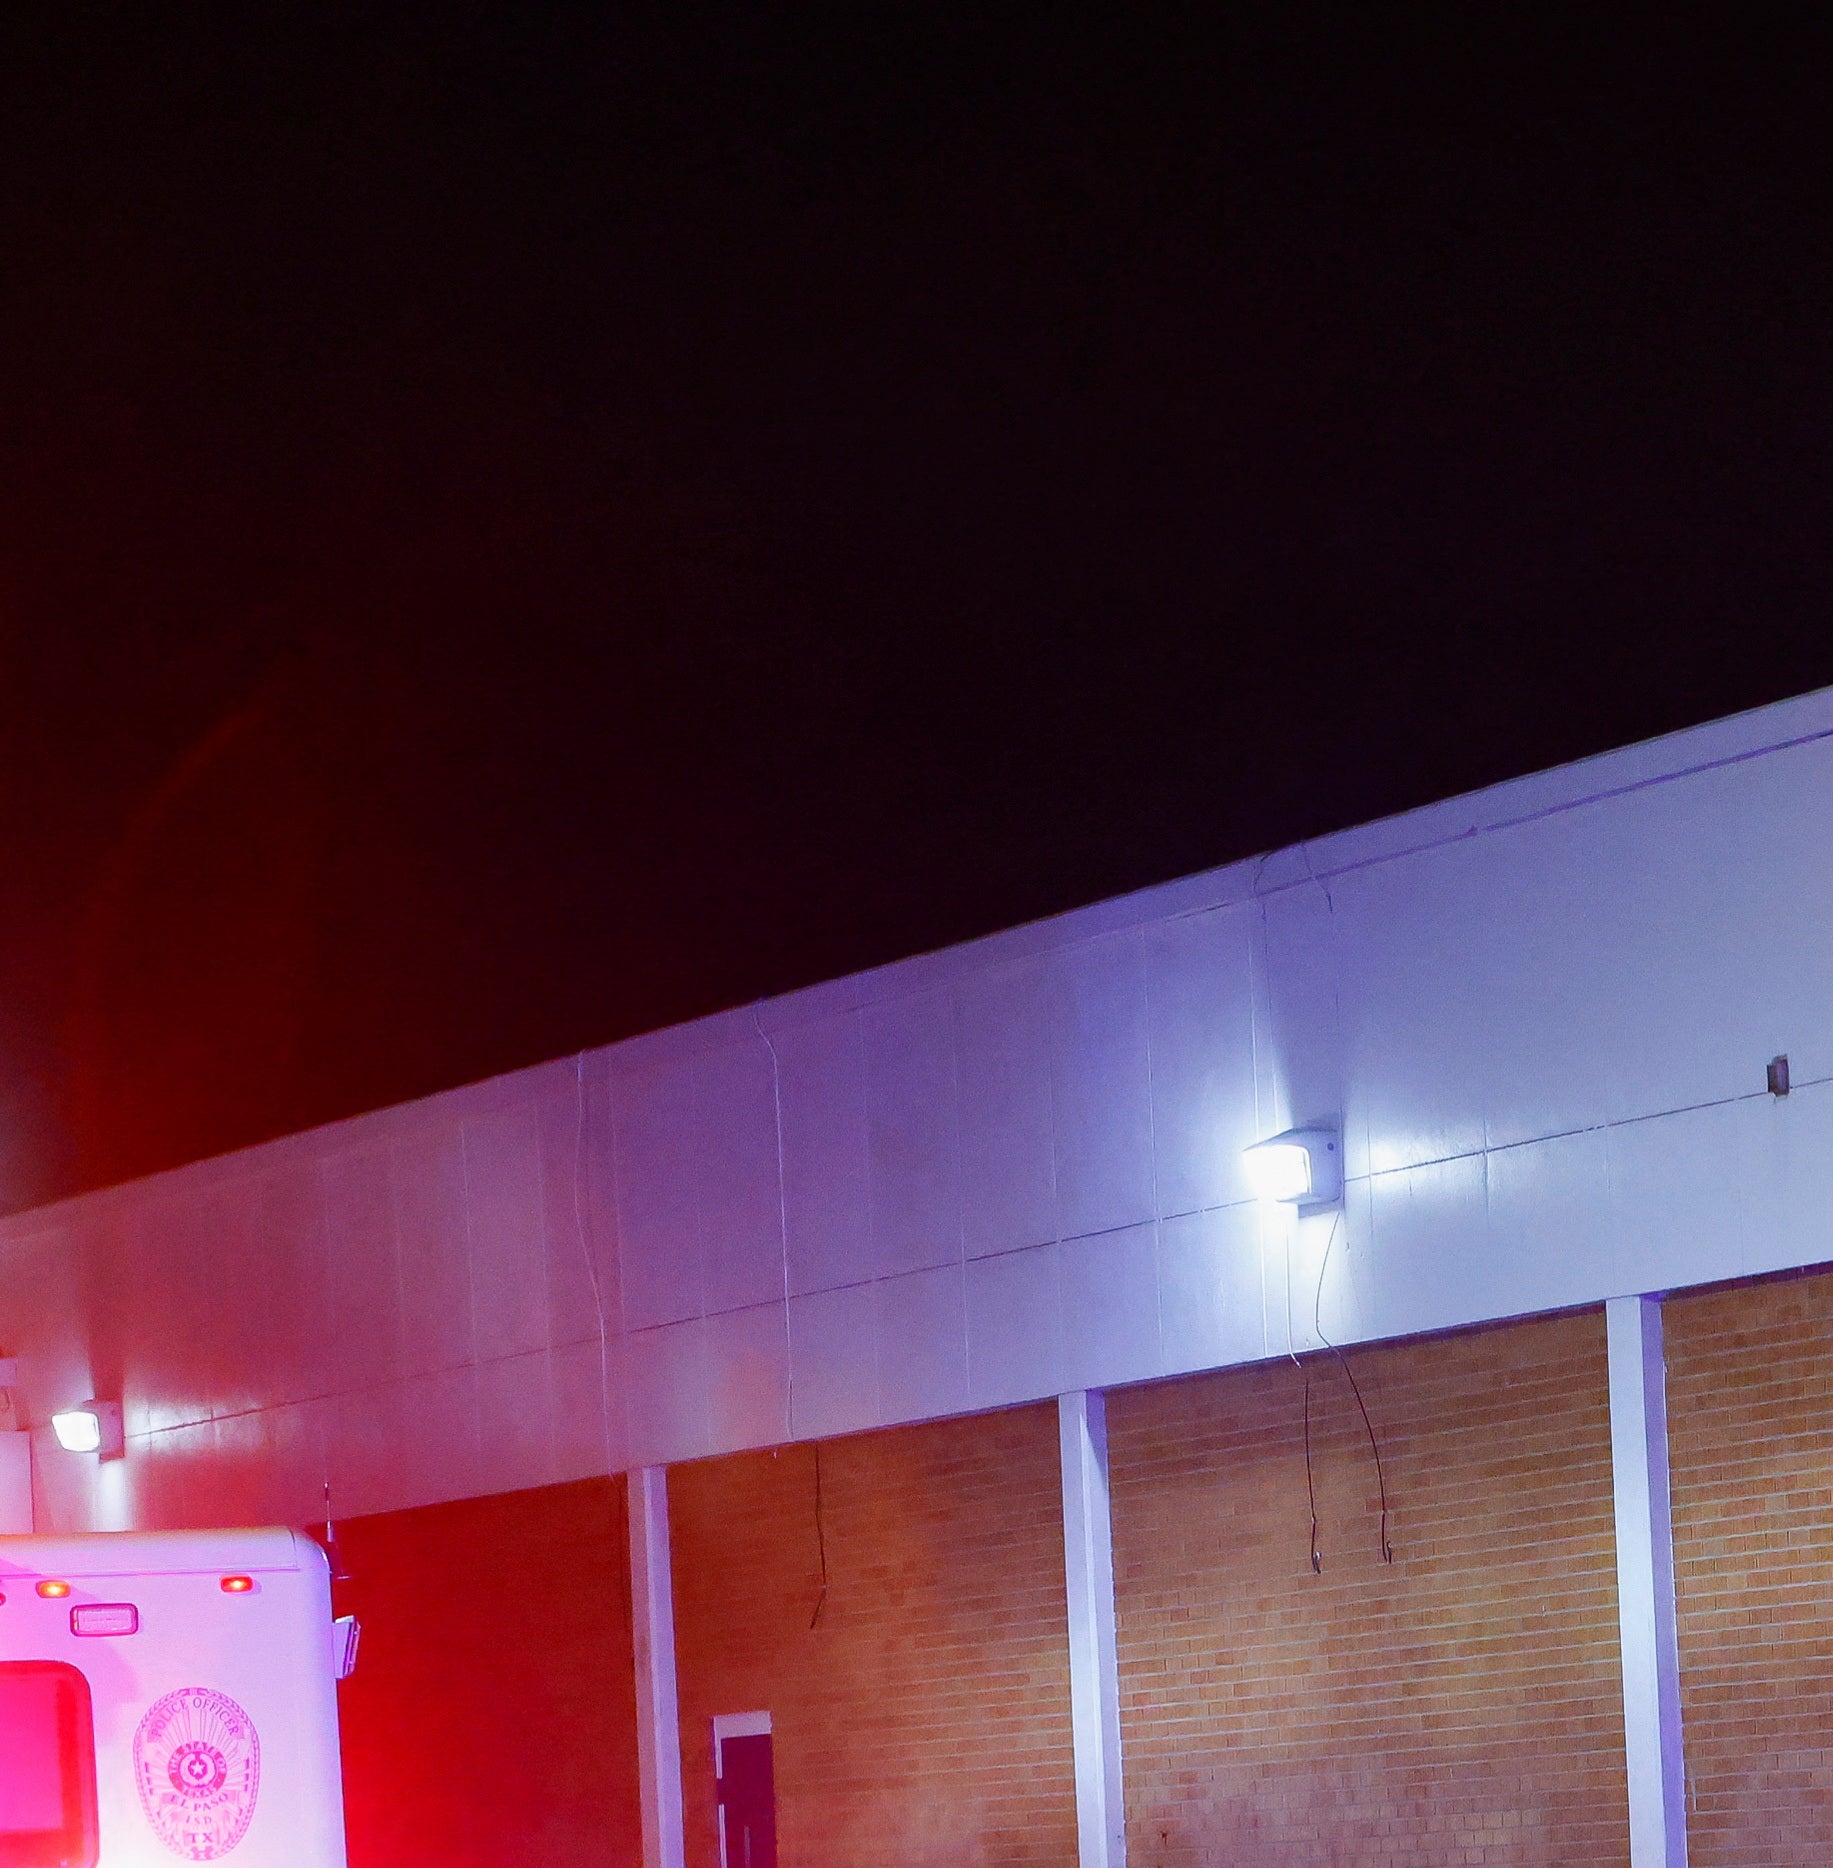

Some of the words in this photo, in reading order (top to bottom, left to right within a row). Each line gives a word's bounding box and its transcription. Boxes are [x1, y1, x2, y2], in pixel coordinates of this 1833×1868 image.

[151, 1698, 189, 1738] POLICE
[192, 1696, 240, 1736] OFFICER
[193, 1792, 229, 1812] PASO
[185, 1832, 214, 1844] TX
